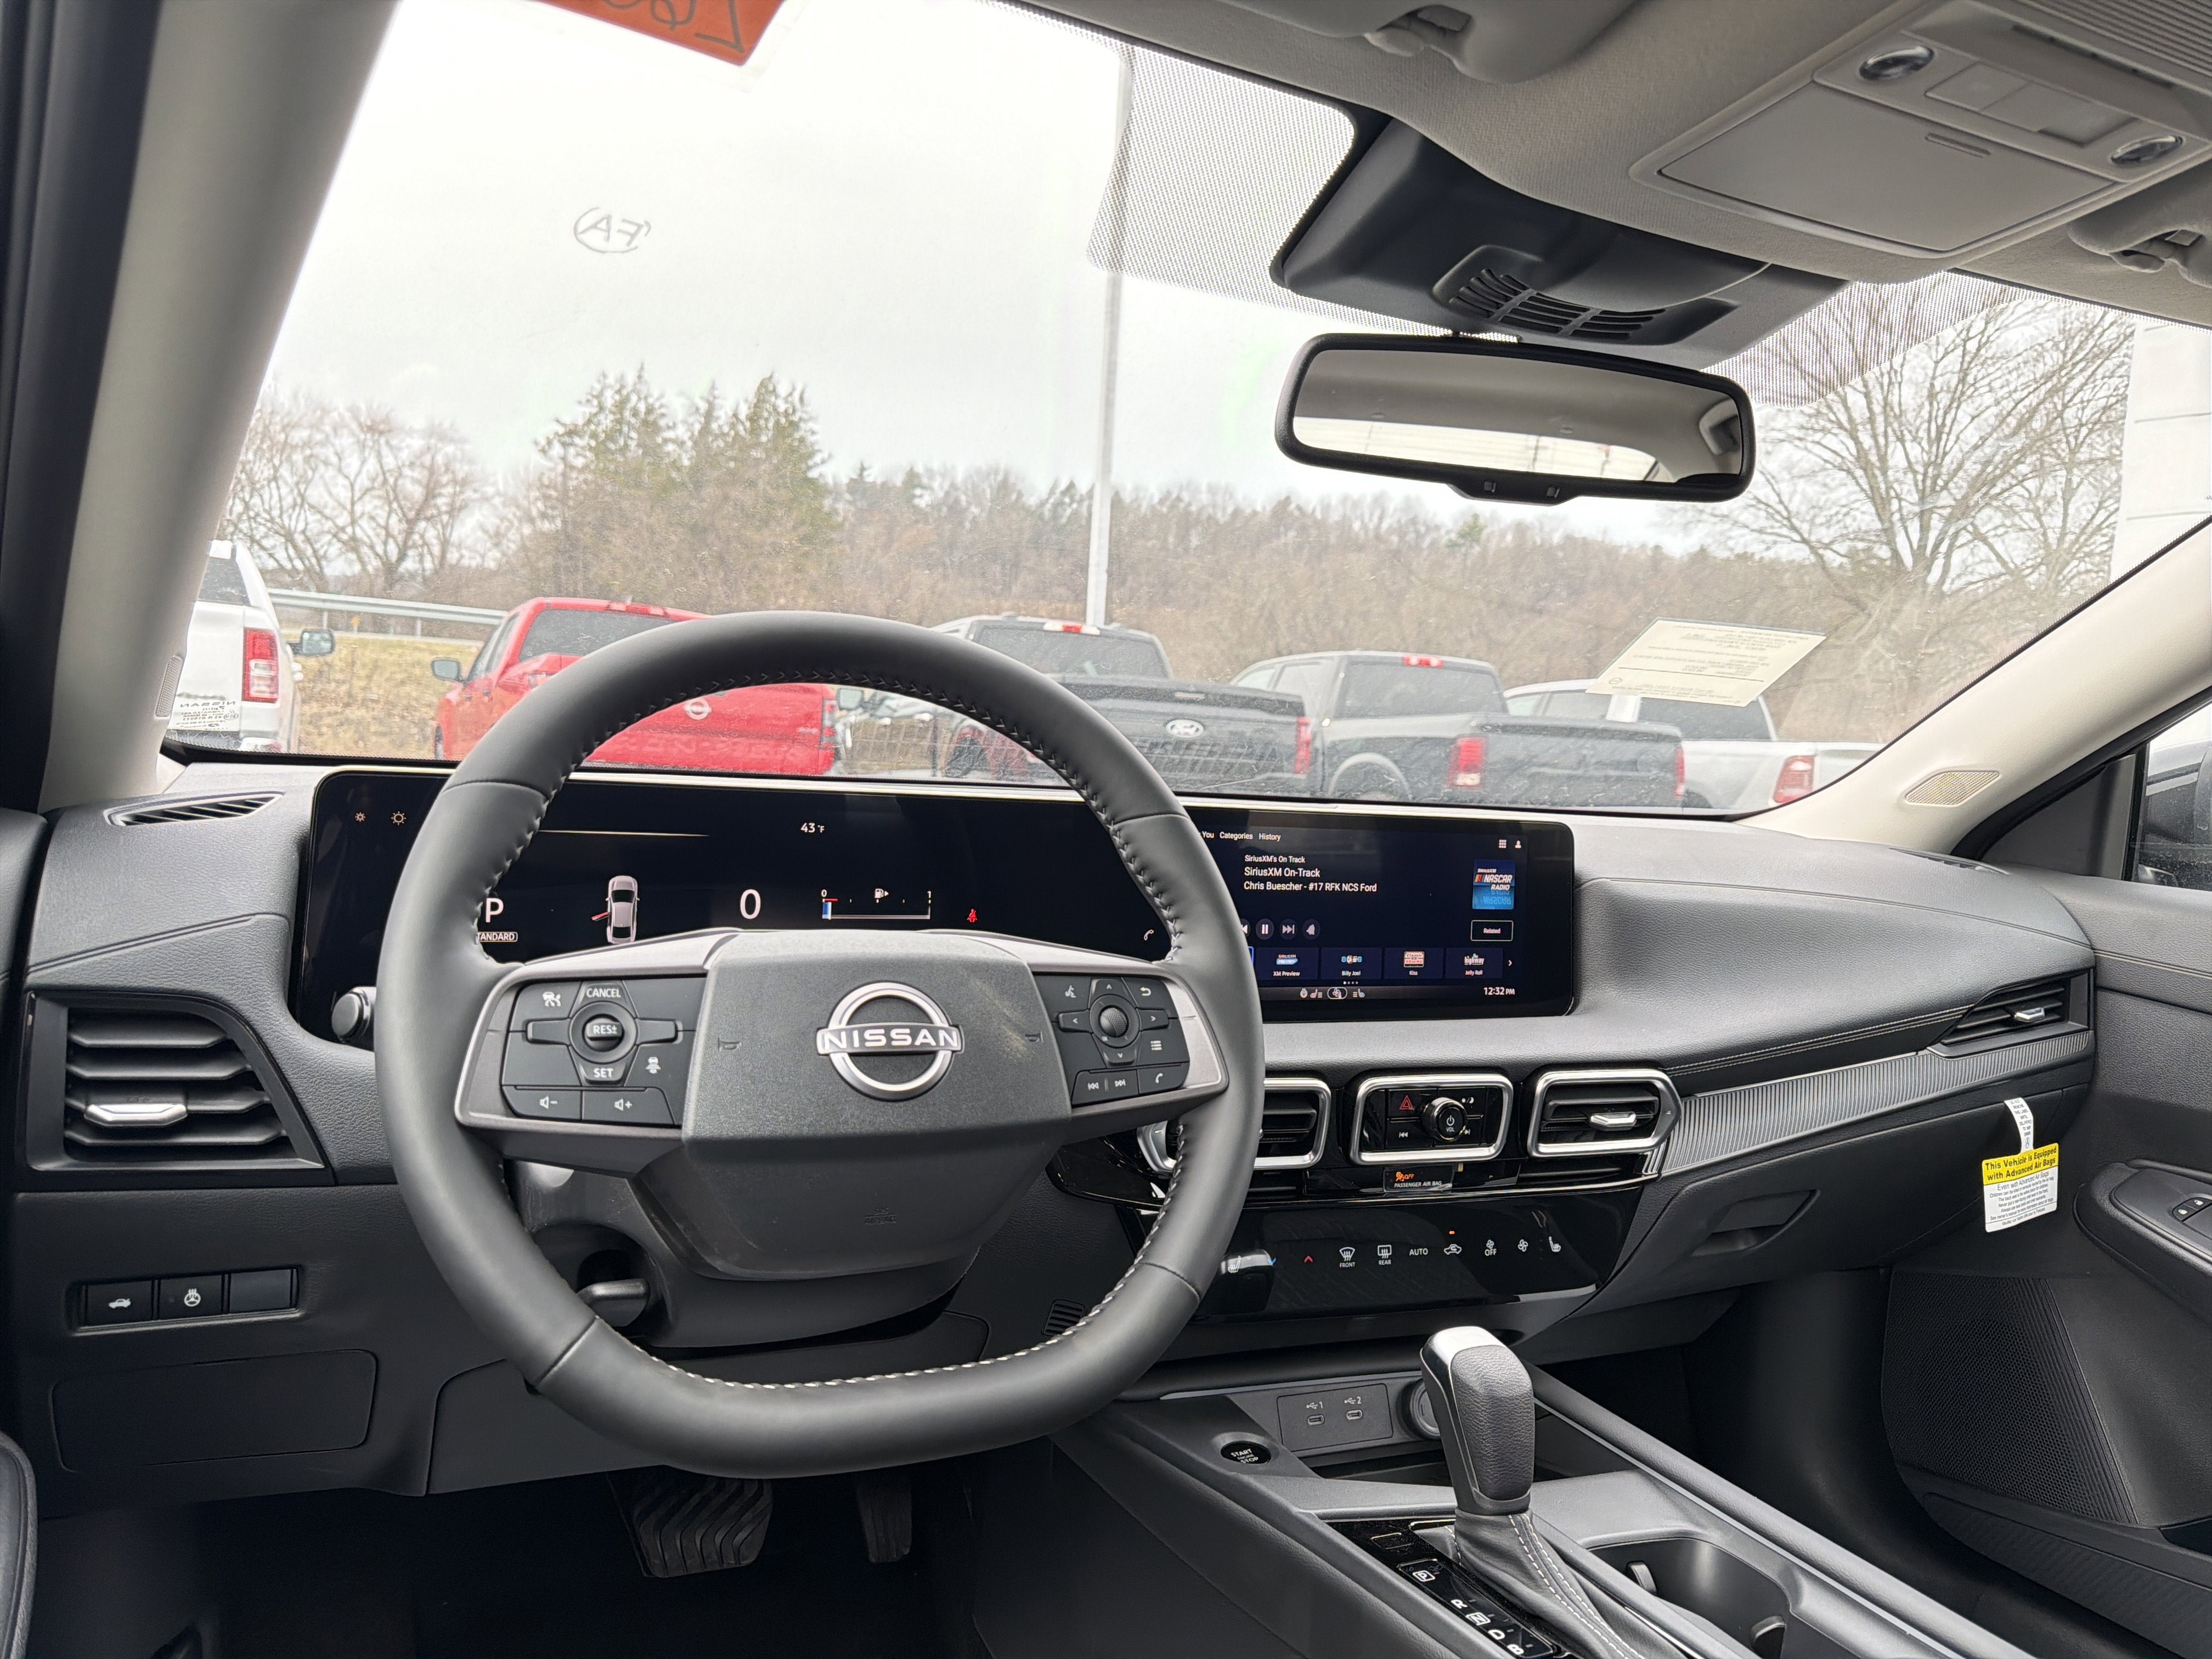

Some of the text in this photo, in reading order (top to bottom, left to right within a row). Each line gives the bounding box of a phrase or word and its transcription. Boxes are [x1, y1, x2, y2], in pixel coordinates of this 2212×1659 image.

[800, 823, 815, 833] 43
[1220, 832, 1253, 840] Categories
[1259, 833, 1280, 842] History
[1244, 855, 1277, 863] SiriusXM's
[1244, 867, 1321, 878] SiriusXM On-Track
[1484, 874, 1513, 883] NASCAR
[1244, 881, 1265, 890] Chris
[1266, 882, 1302, 891] Buescher
[1308, 883, 1323, 891] #17
[1325, 883, 1340, 891] RFK
[1342, 883, 1358, 891] NCS
[1360, 883, 1378, 892] Ford
[740, 889, 761, 919] 0
[485, 898, 504, 923] P
[477, 932, 515, 941] TANDARD
[1464, 956, 1485, 965] highway
[586, 988, 622, 998] CANCEL
[1484, 987, 1504, 995] 12:32
[824, 1028, 958, 1050] NISSAN
[593, 1068, 613, 1078] SET
[1985, 1161, 2001, 1171] This
[2003, 1156, 2027, 1167] Vehicle
[2034, 1146, 2057, 1160] Equipped
[1987, 1172, 2003, 1181] with
[2006, 1163, 2033, 1178] Advanced
[2043, 1158, 2056, 1166] Bags
[2019, 1176, 2035, 1186] Advanced
[1409, 1248, 1429, 1256] AUTO
[1485, 1248, 1497, 1256] OFF
[1356, 1396, 1362, 1404] 2
[1231, 1448, 1252, 1457] START
[1451, 1599, 1468, 1609] R
[1471, 1613, 1485, 1624] N
[1488, 1629, 1505, 1640] D
[1507, 1644, 1525, 1655] B
